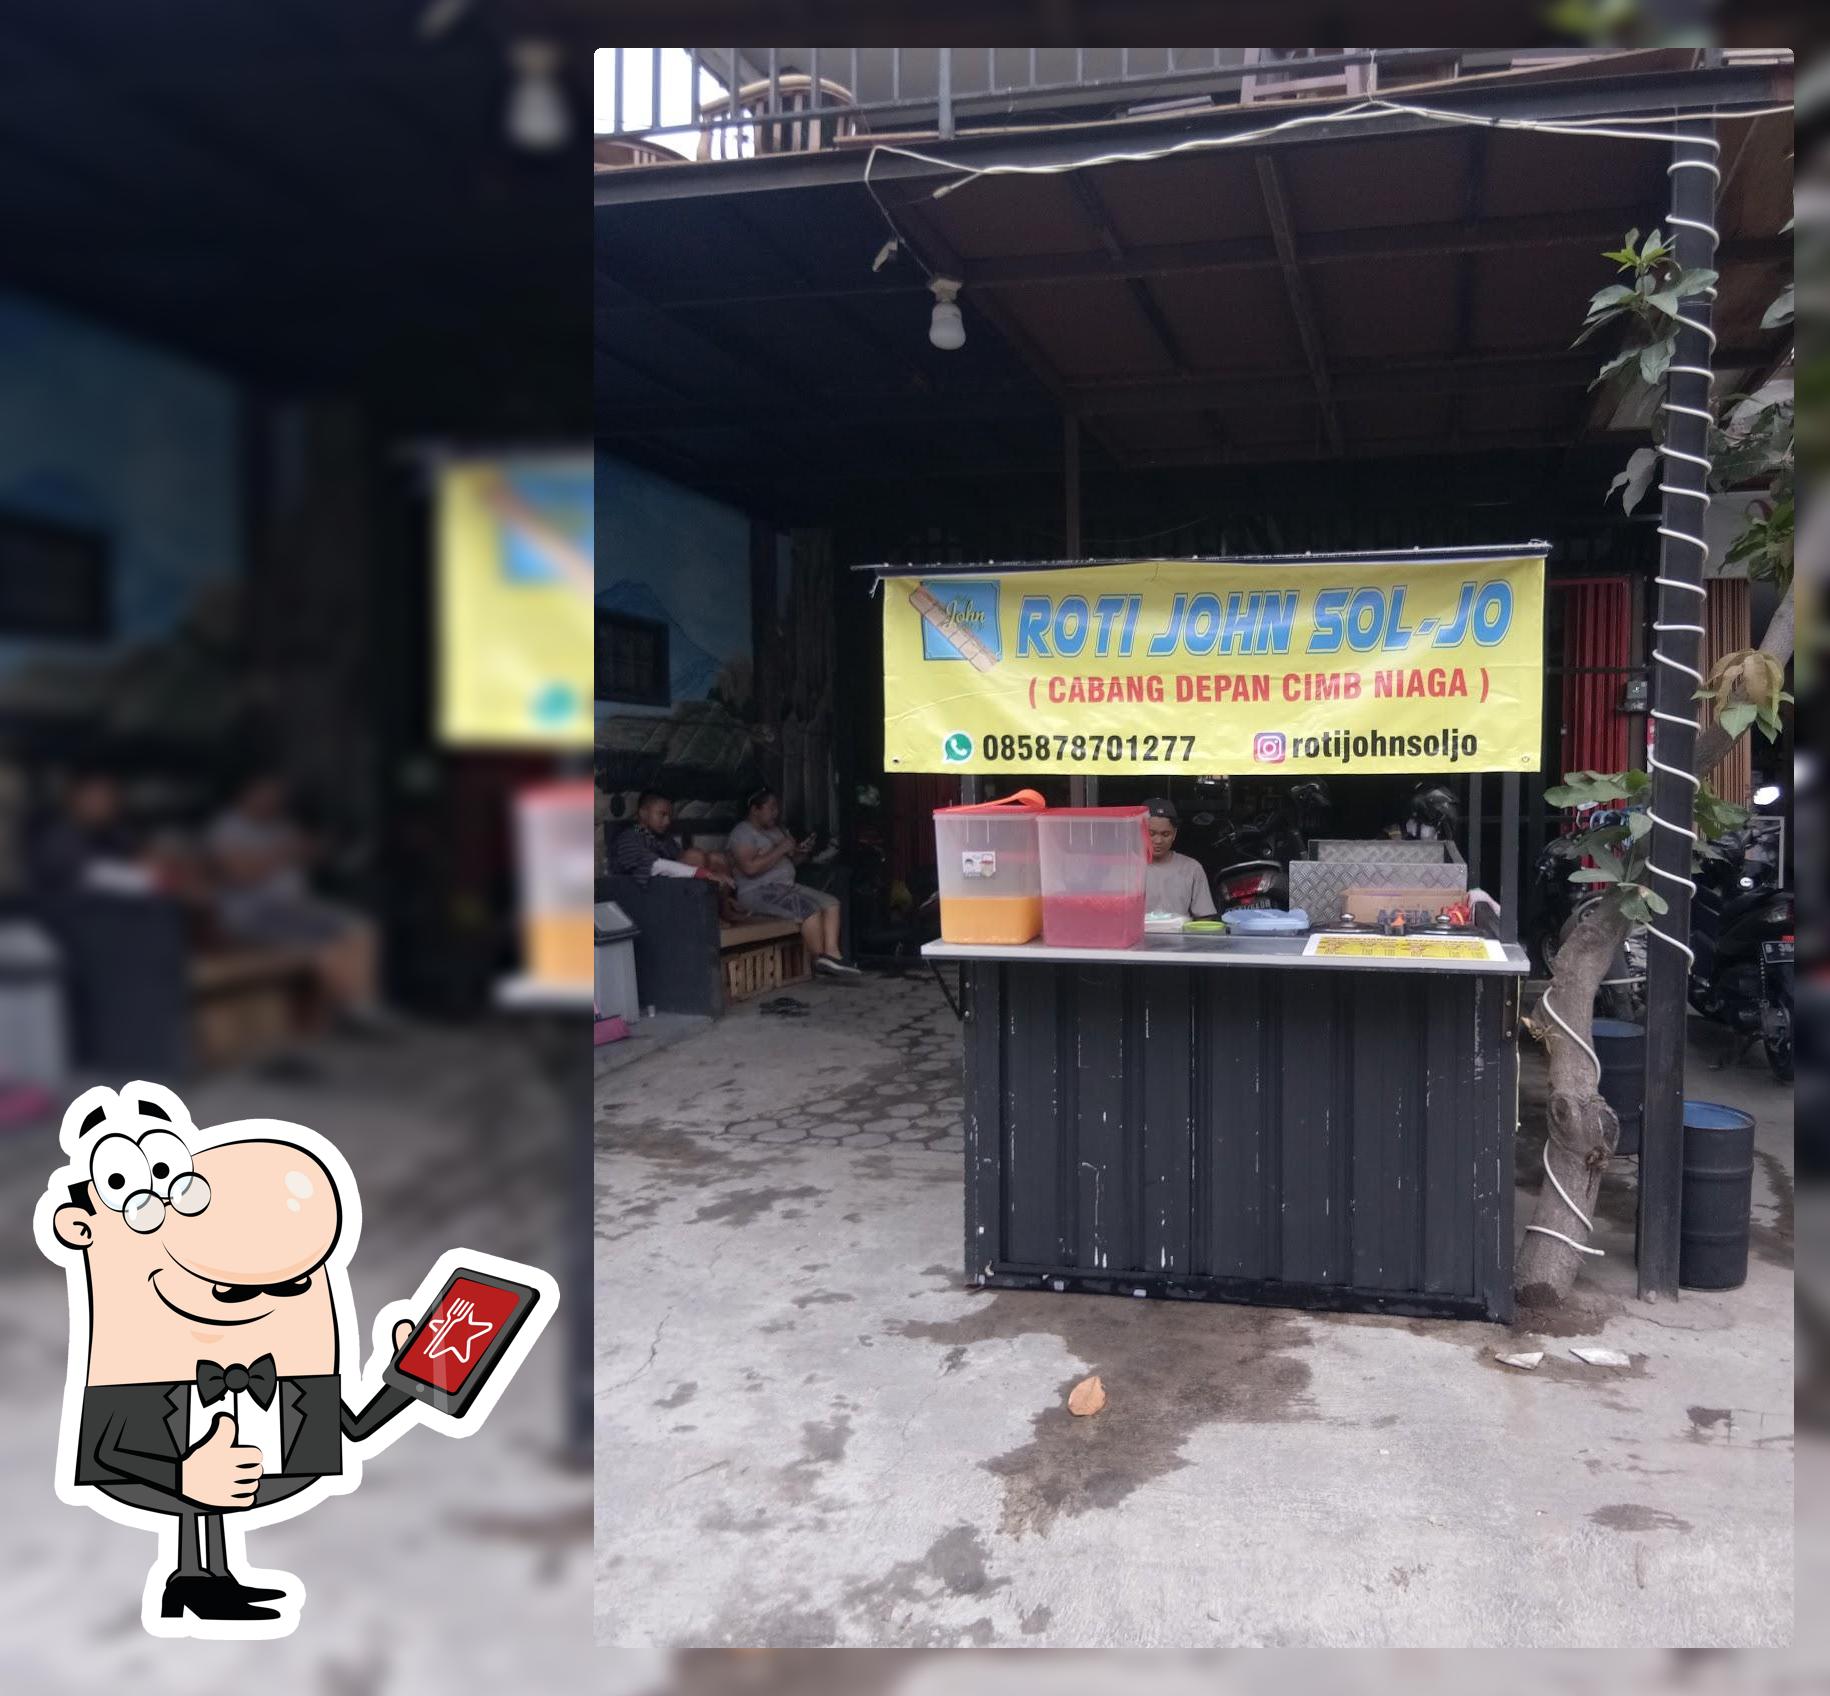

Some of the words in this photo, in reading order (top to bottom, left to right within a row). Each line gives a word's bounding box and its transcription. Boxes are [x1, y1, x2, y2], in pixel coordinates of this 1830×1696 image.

[1015, 594, 1142, 657] ROTI
[1147, 588, 1300, 657] JOHN
[1305, 578, 1515, 654] SOL-JO
[1048, 675, 1164, 704] CABANG
[1175, 674, 1271, 703] DEPAN
[1281, 672, 1361, 702] CIMB
[1375, 667, 1468, 698] NIAGA
[982, 734, 1196, 762] 085878701277
[1292, 728, 1478, 764] rotijohnsoljo
